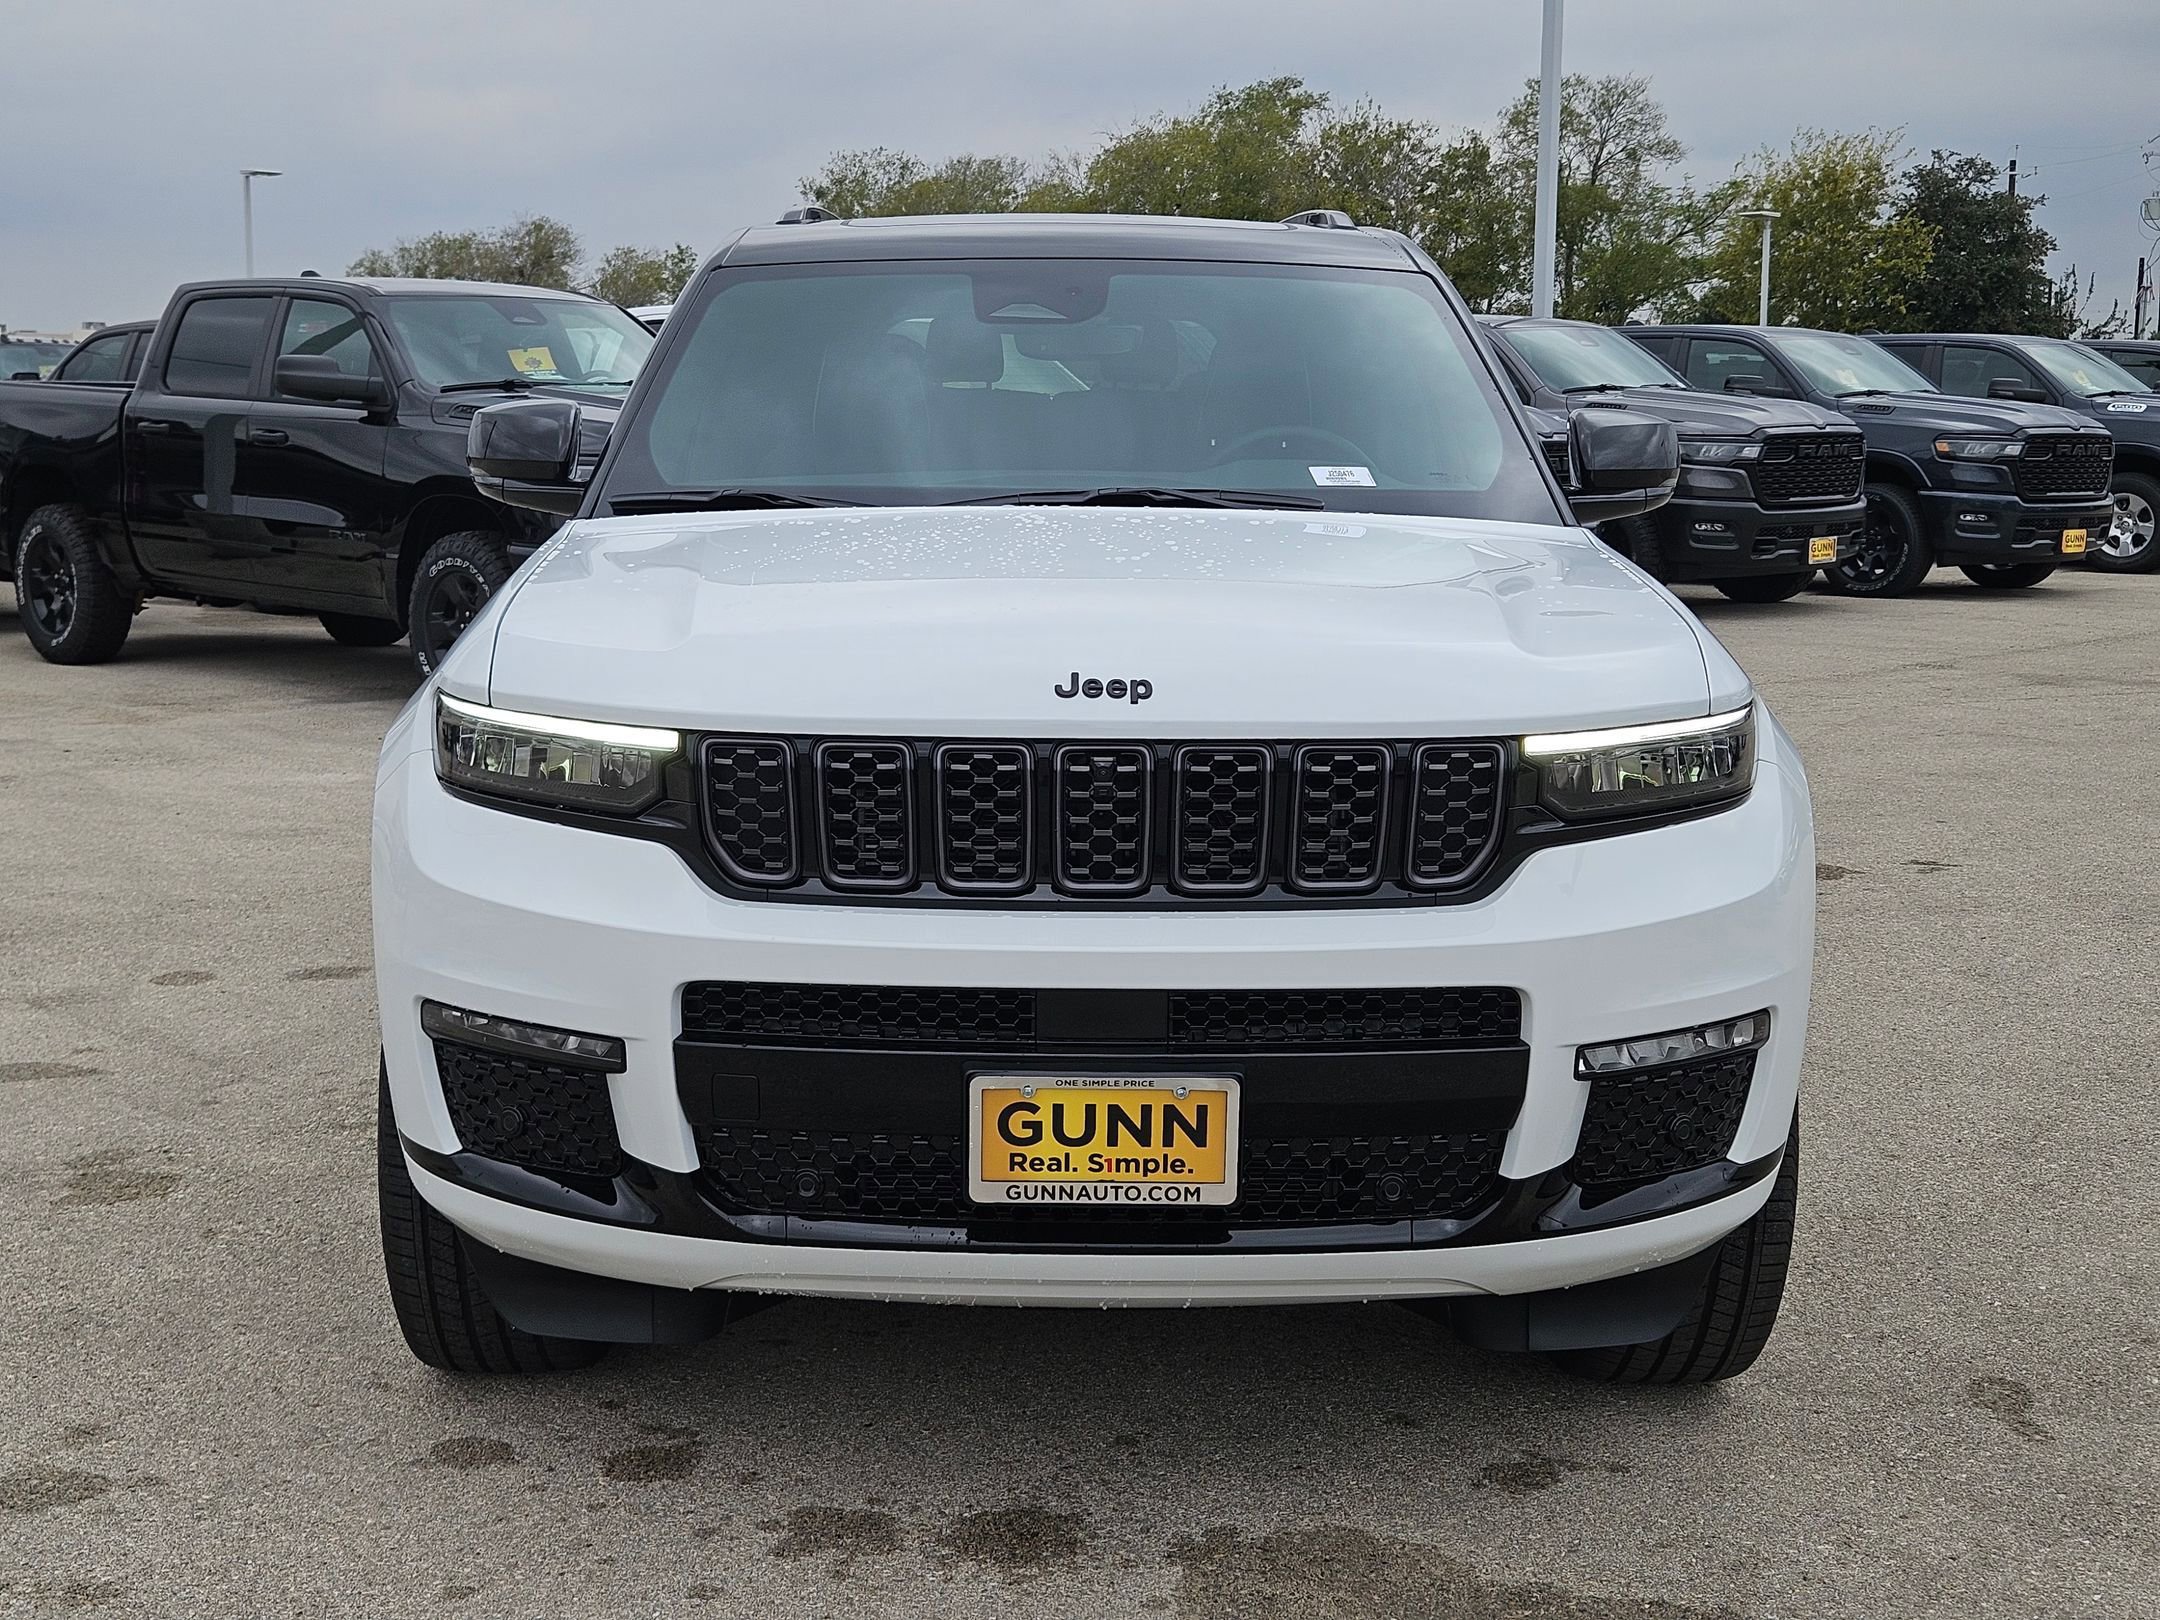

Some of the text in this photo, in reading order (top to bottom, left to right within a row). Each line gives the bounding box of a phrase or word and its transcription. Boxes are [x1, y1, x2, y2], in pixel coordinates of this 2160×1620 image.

[1810, 542, 1834, 553] GUNN
[2064, 534, 2085, 544] GUNN
[429, 557, 491, 598] GOODYEA
[1054, 672, 1153, 704] Jeep
[1055, 1079, 1155, 1088] ONE SIMPLE PRICE
[997, 1101, 1208, 1148] GUNN
[1008, 1152, 1078, 1173] Real.
[1005, 1184, 1201, 1202] GUNNAUTO.COM
